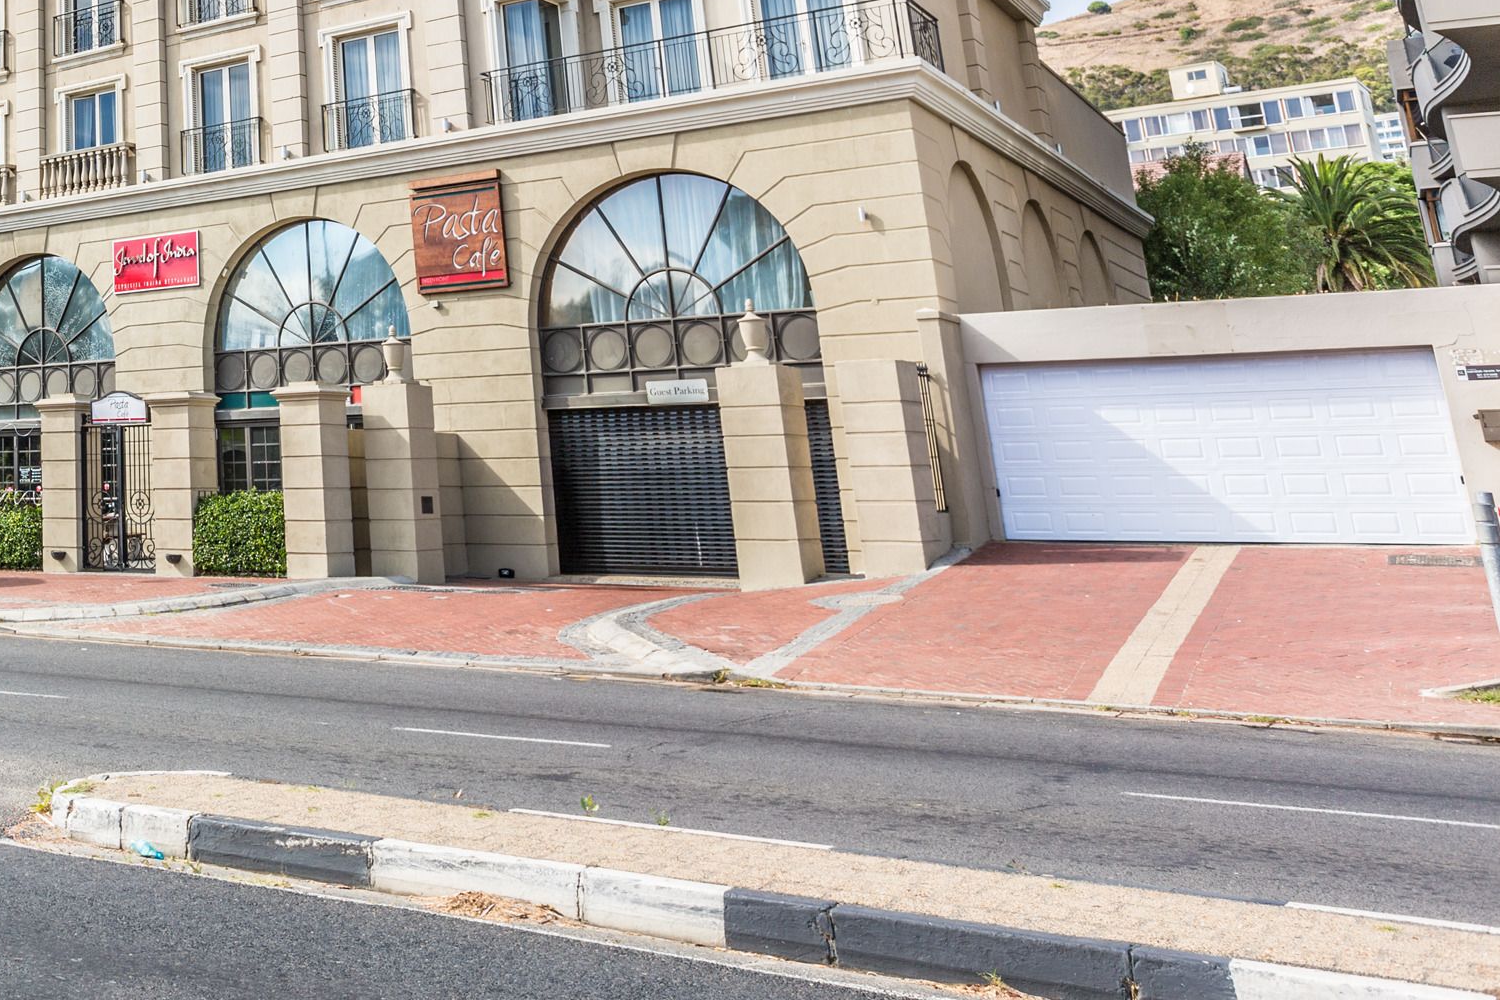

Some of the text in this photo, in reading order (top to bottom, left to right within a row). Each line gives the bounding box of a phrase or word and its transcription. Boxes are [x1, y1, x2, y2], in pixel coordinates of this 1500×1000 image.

[414, 194, 498, 241] Pasta
[113, 238, 196, 279] Jewel of India
[453, 236, 501, 277] Café
[107, 398, 129, 409] Pasta
[649, 386, 706, 396] Guest Parking
